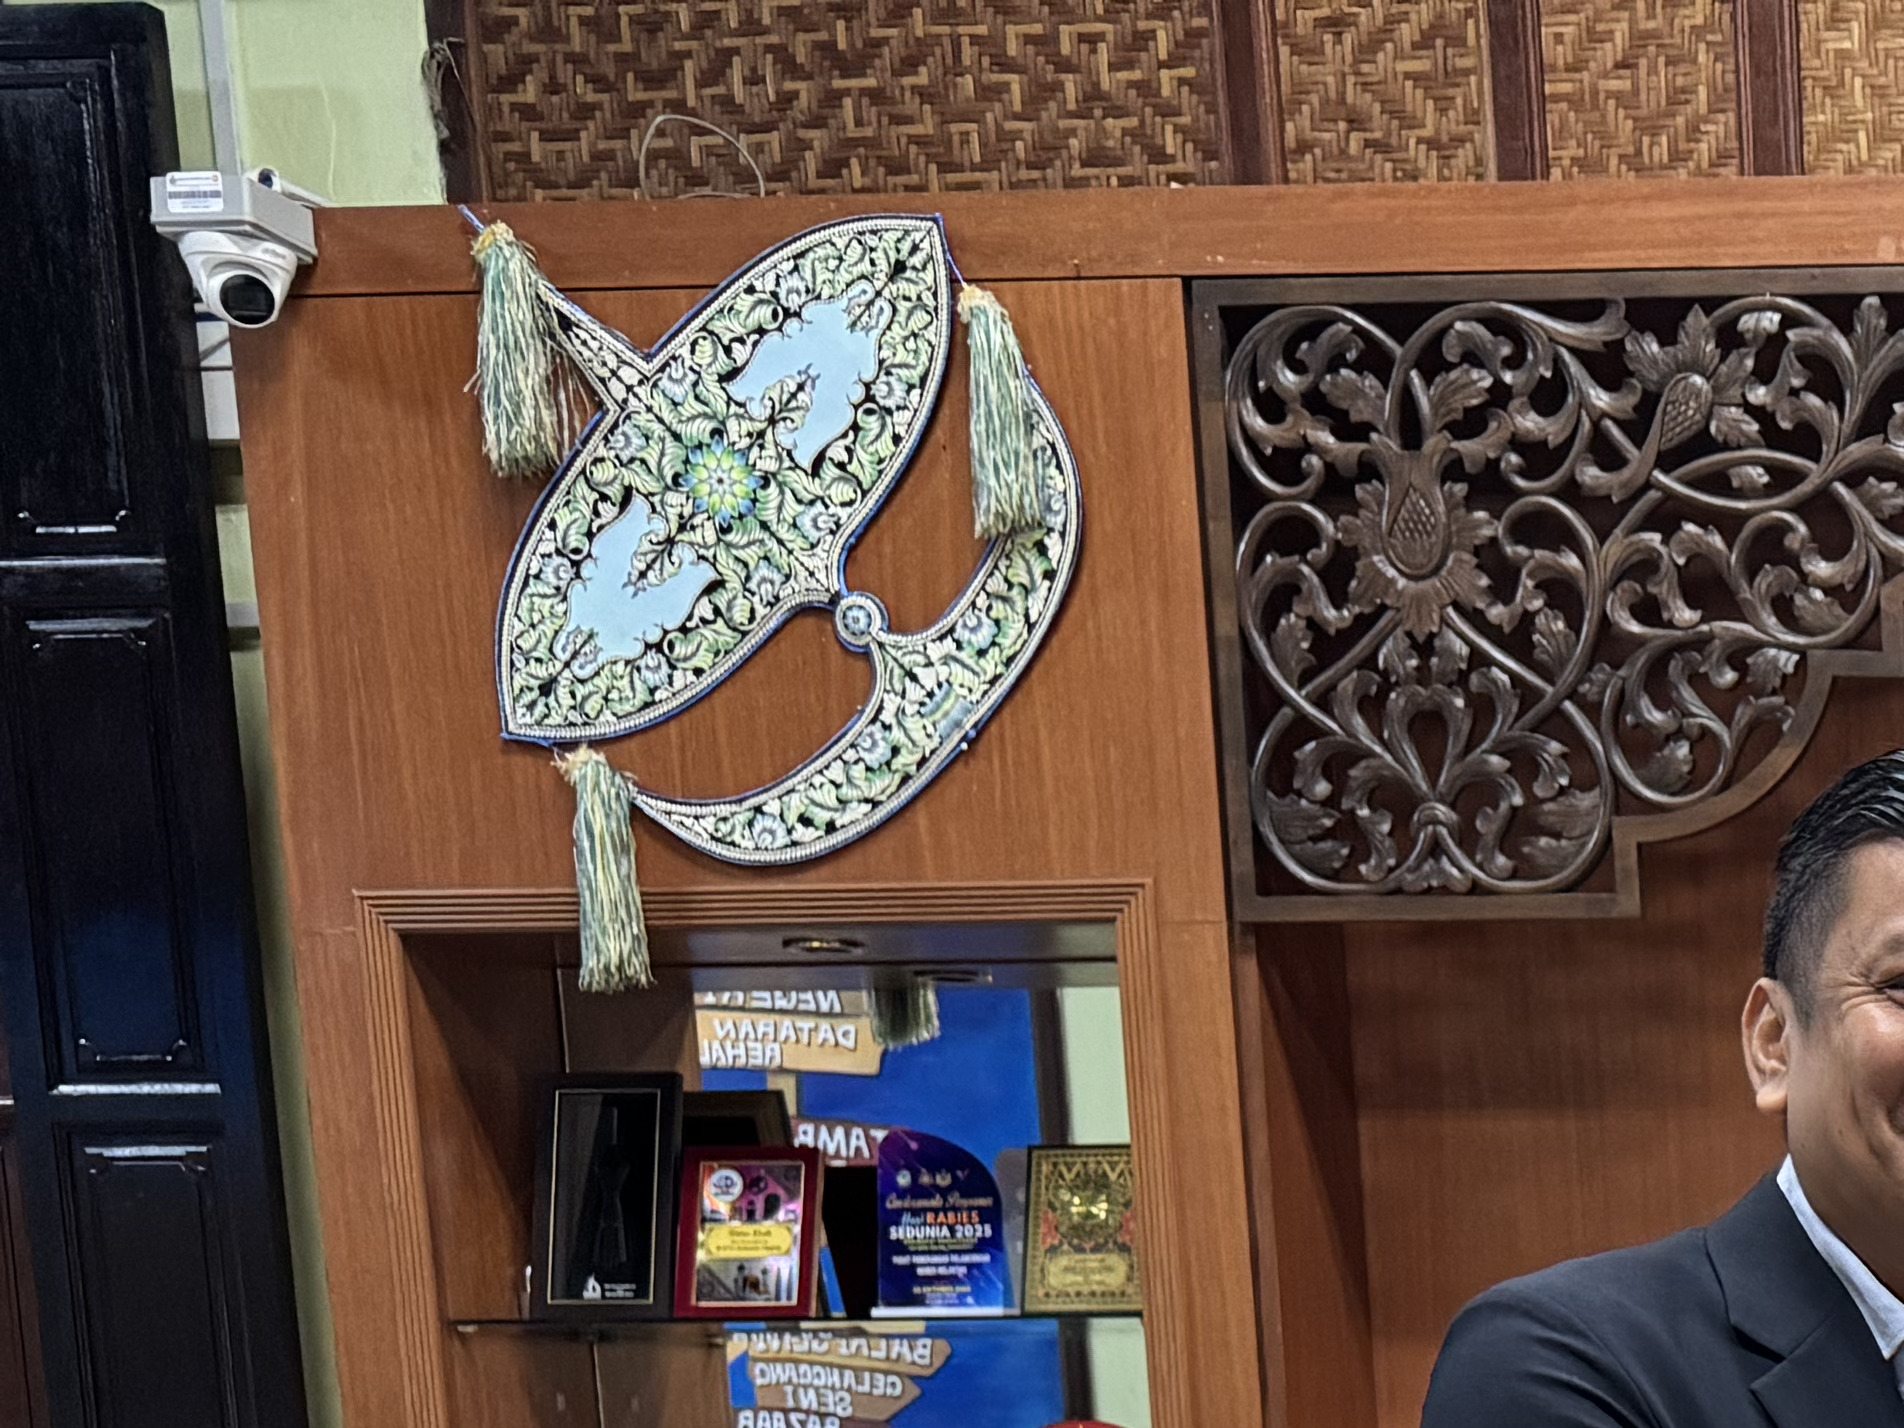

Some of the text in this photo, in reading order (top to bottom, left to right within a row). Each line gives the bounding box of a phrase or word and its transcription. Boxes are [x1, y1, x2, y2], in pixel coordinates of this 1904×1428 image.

[926, 1210, 979, 1225] RABIES
[889, 1223, 993, 1240] SEDUNIA 2025
